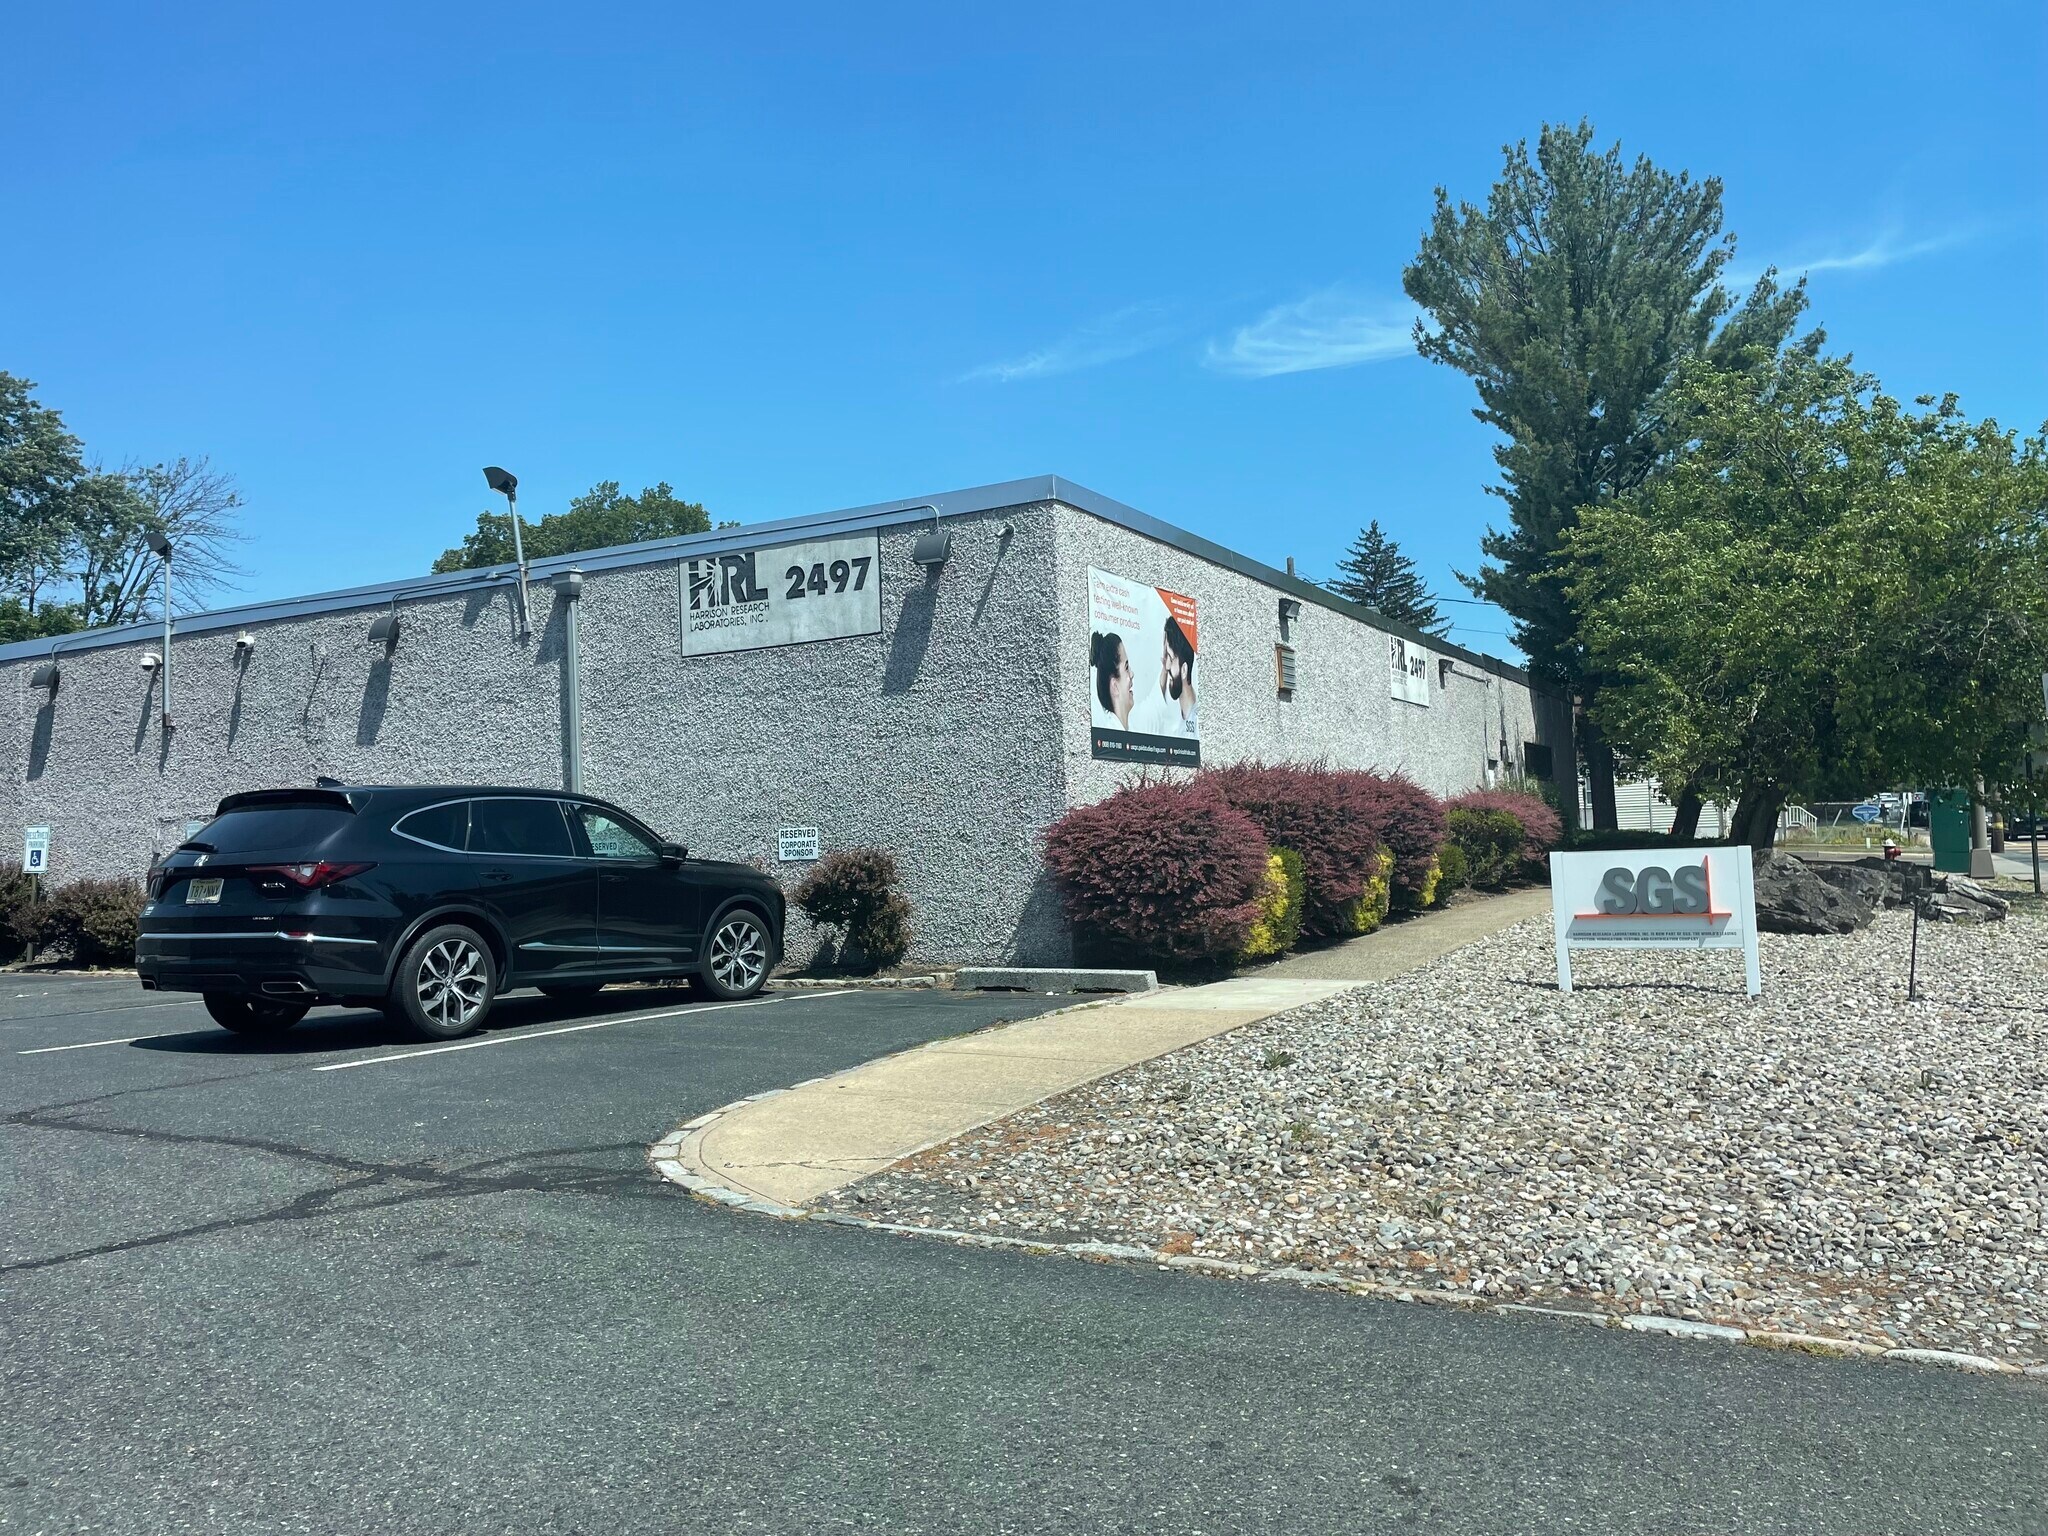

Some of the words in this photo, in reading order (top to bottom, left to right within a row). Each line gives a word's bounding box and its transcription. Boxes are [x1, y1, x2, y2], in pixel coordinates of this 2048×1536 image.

[688, 552, 768, 609] HRL
[785, 556, 872, 599] 2497
[690, 608, 728, 621] HARRISON
[731, 602, 770, 614] RESEARCH
[690, 617, 747, 632] LABORATORIES,
[1410, 656, 1425, 679] 2497
[781, 829, 816, 839] RESERVED
[592, 842, 617, 850] ESERVED
[781, 840, 816, 849] CORPORATE
[784, 849, 814, 857] SPONSOR
[1601, 865, 1709, 914] SGS
